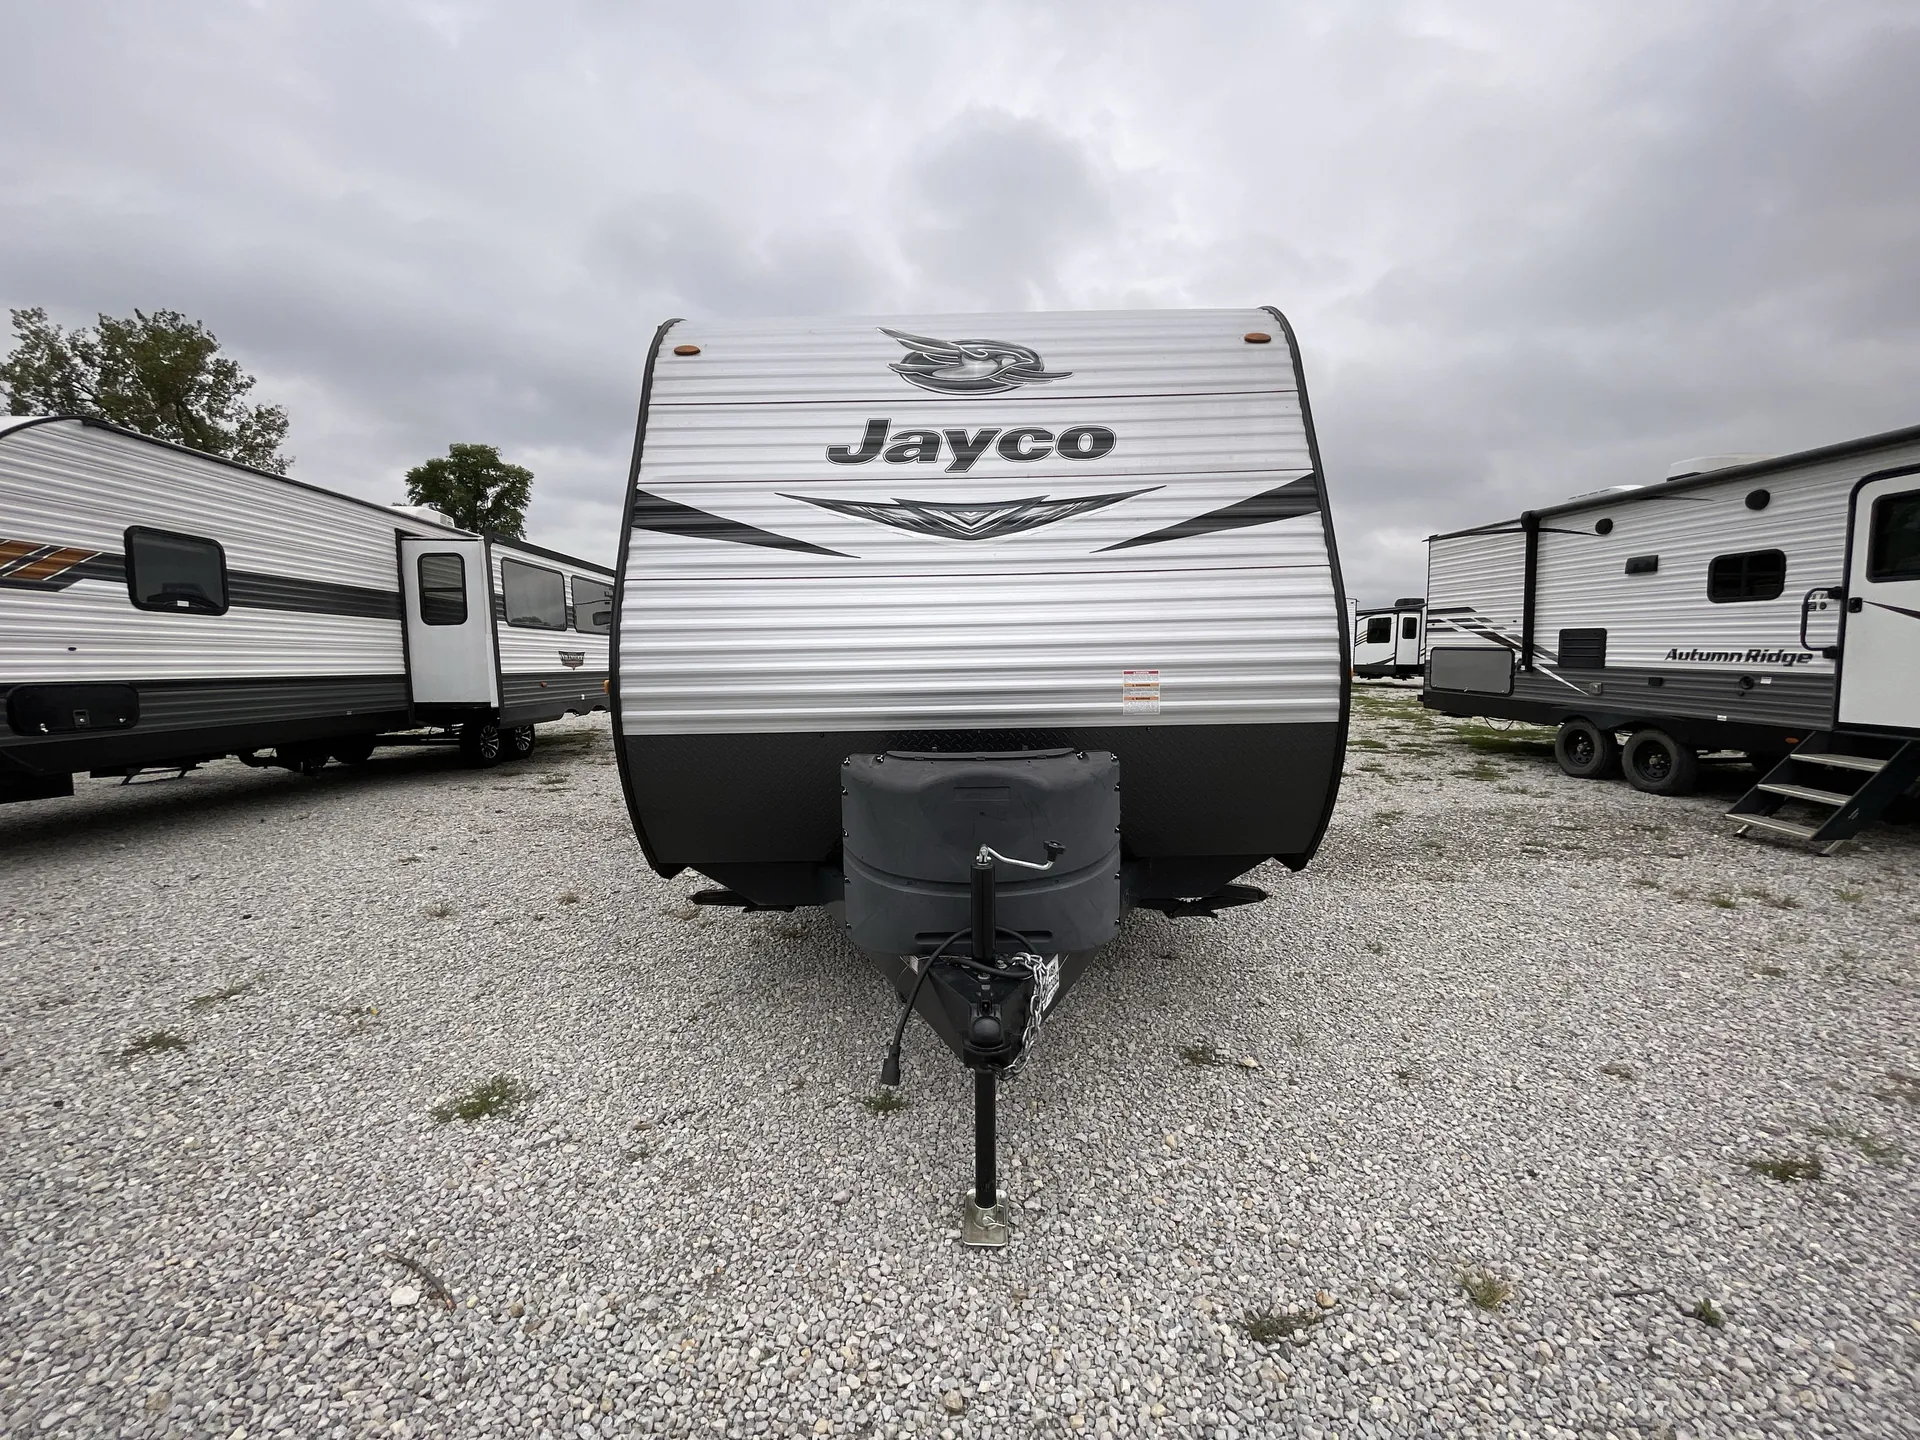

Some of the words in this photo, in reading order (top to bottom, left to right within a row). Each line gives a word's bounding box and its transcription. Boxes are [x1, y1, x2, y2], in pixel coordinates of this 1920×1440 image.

[826, 418, 1116, 472] Jayco
[1665, 648, 1743, 662] Autumn
[1744, 649, 1813, 666] Ridge
